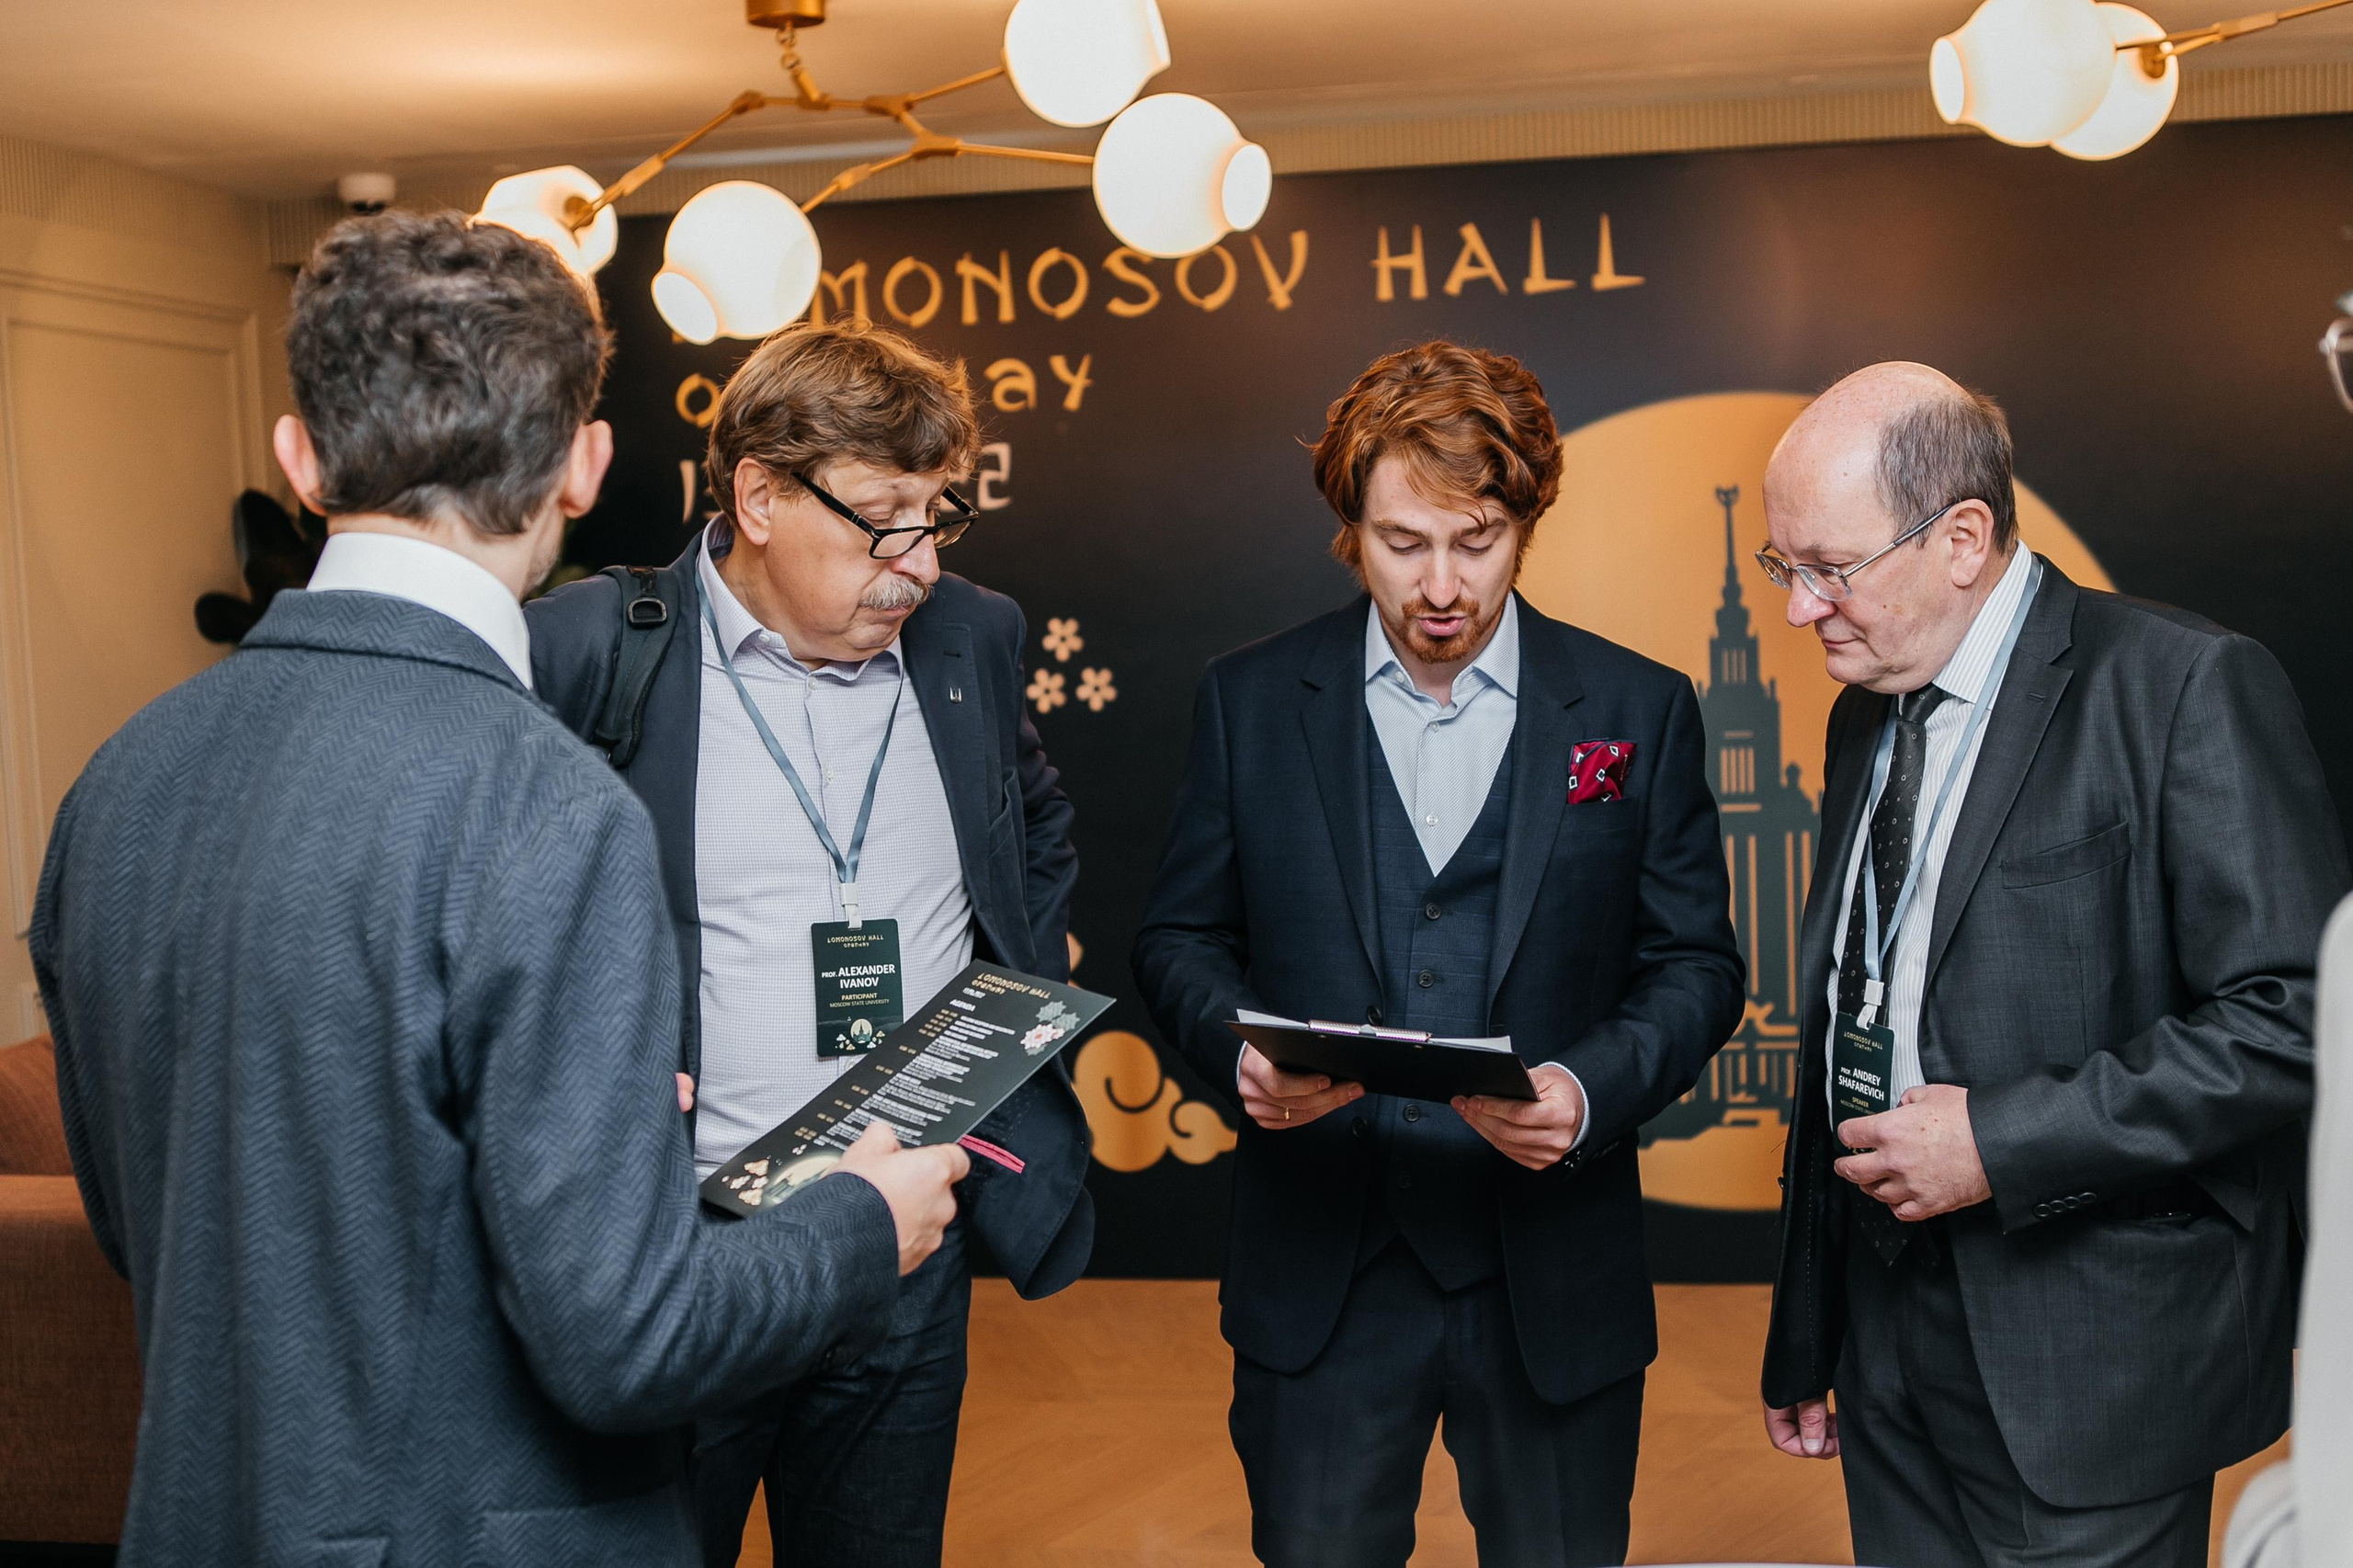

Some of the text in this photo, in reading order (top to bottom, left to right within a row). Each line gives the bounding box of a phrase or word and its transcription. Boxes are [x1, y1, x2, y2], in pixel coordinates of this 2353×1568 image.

[672, 213, 1646, 343] MONOSOV HALL
[827, 935, 866, 943] LOMONOSOV
[838, 964, 896, 977] ALEXANDER
[839, 977, 879, 989] IVANOV
[841, 993, 878, 1001] PARTICIPANT
[1852, 1067, 1881, 1086] ANDREY
[1838, 1074, 1884, 1101] SHAFAREVICH
[1852, 1096, 1869, 1108] SPEAKER
